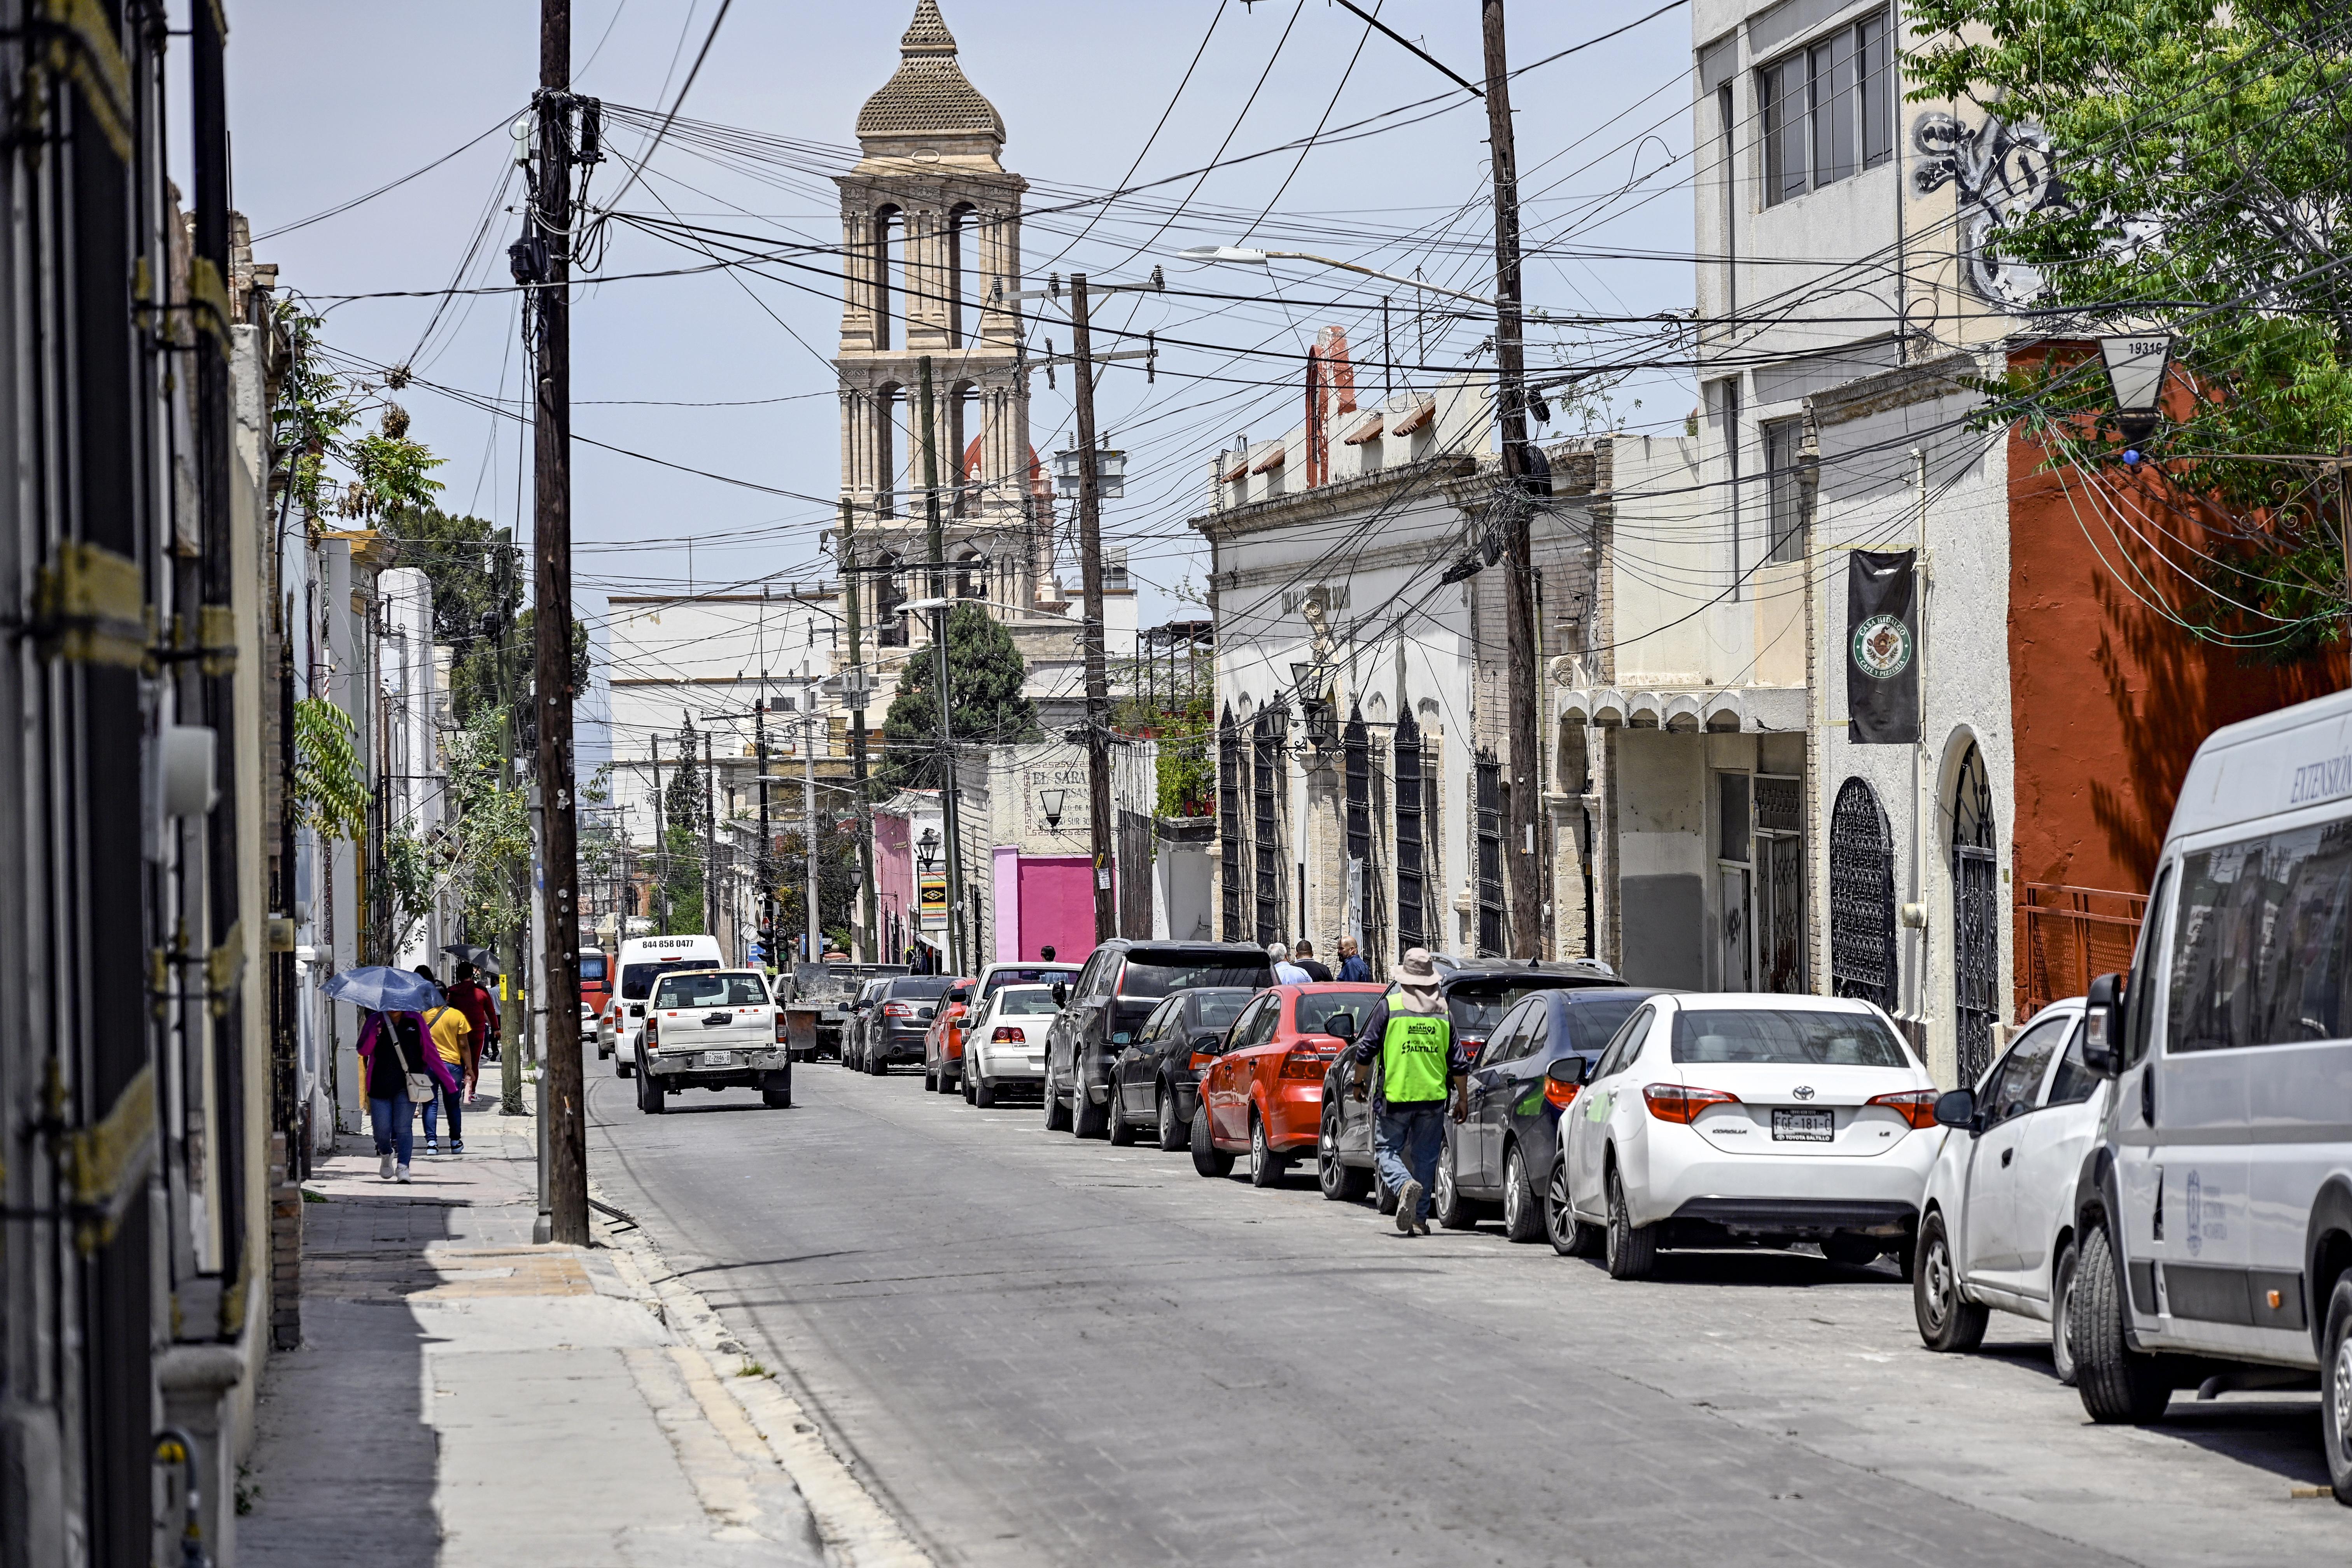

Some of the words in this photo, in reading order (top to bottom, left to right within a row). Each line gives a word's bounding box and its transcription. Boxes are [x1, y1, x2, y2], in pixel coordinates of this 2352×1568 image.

[2129, 342, 2162, 355] 19316
[1859, 619, 1876, 636] CASA
[1877, 616, 1906, 635] HIDALGO
[1860, 660, 1874, 674] CAFÉ
[1033, 772, 1049, 784] EL
[1055, 771, 1090, 784] SARA
[1775, 1116, 1830, 1131] FGE-181-C
